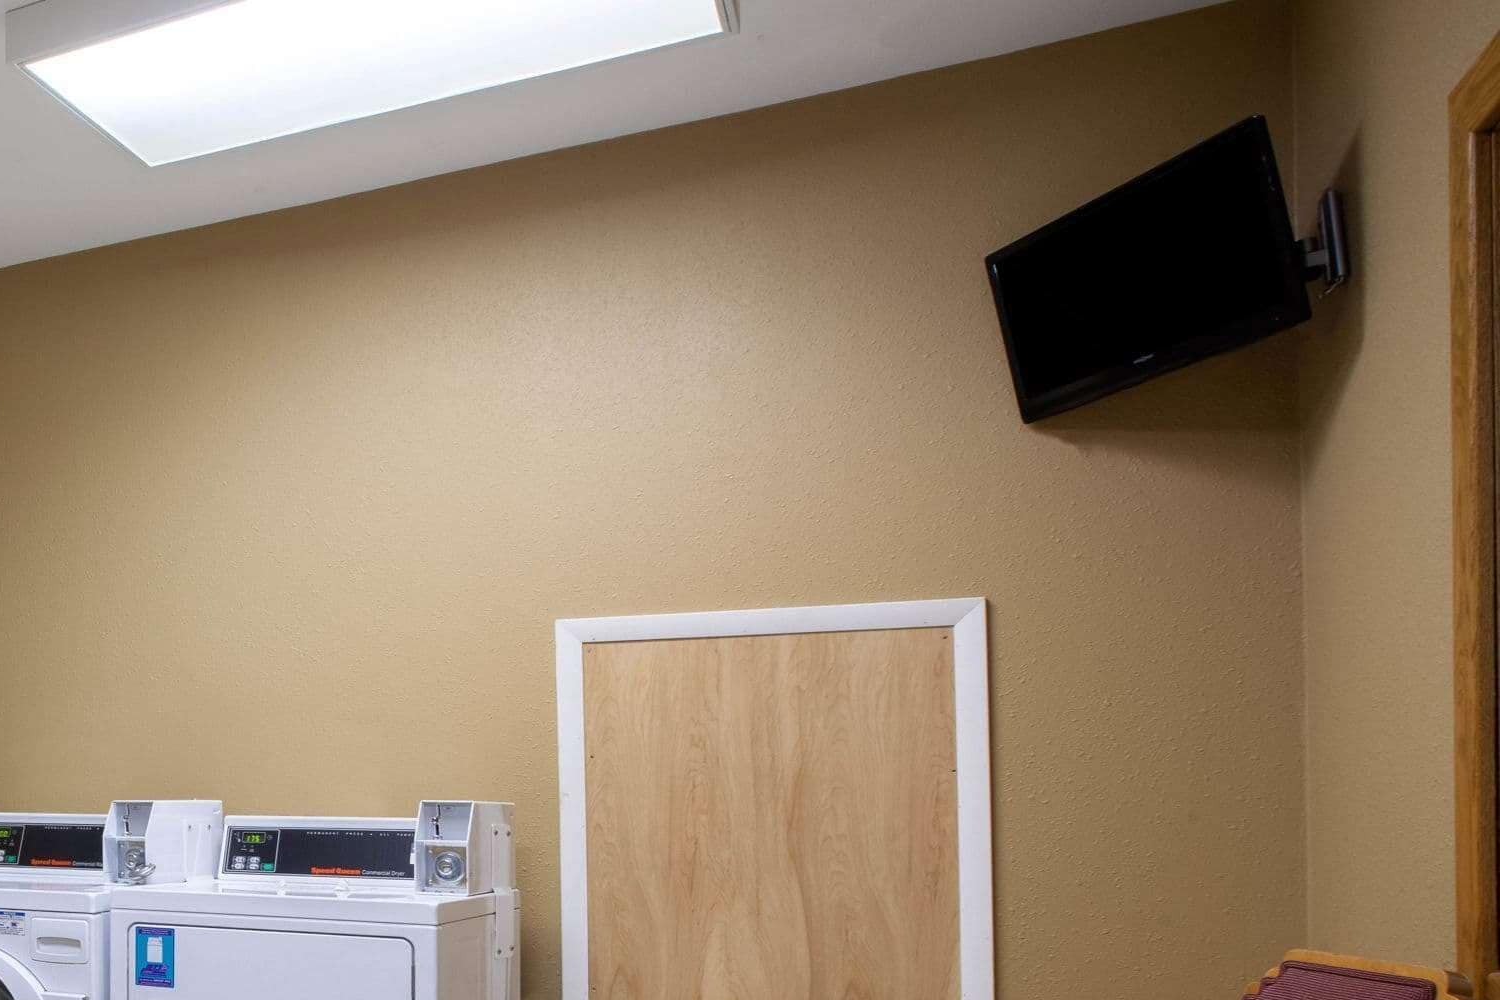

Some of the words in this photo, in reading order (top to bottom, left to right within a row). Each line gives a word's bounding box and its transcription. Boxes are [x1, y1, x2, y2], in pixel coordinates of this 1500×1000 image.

[311, 866, 336, 875] Speed
[336, 866, 361, 875] Queen
[391, 870, 406, 878] Dryer
